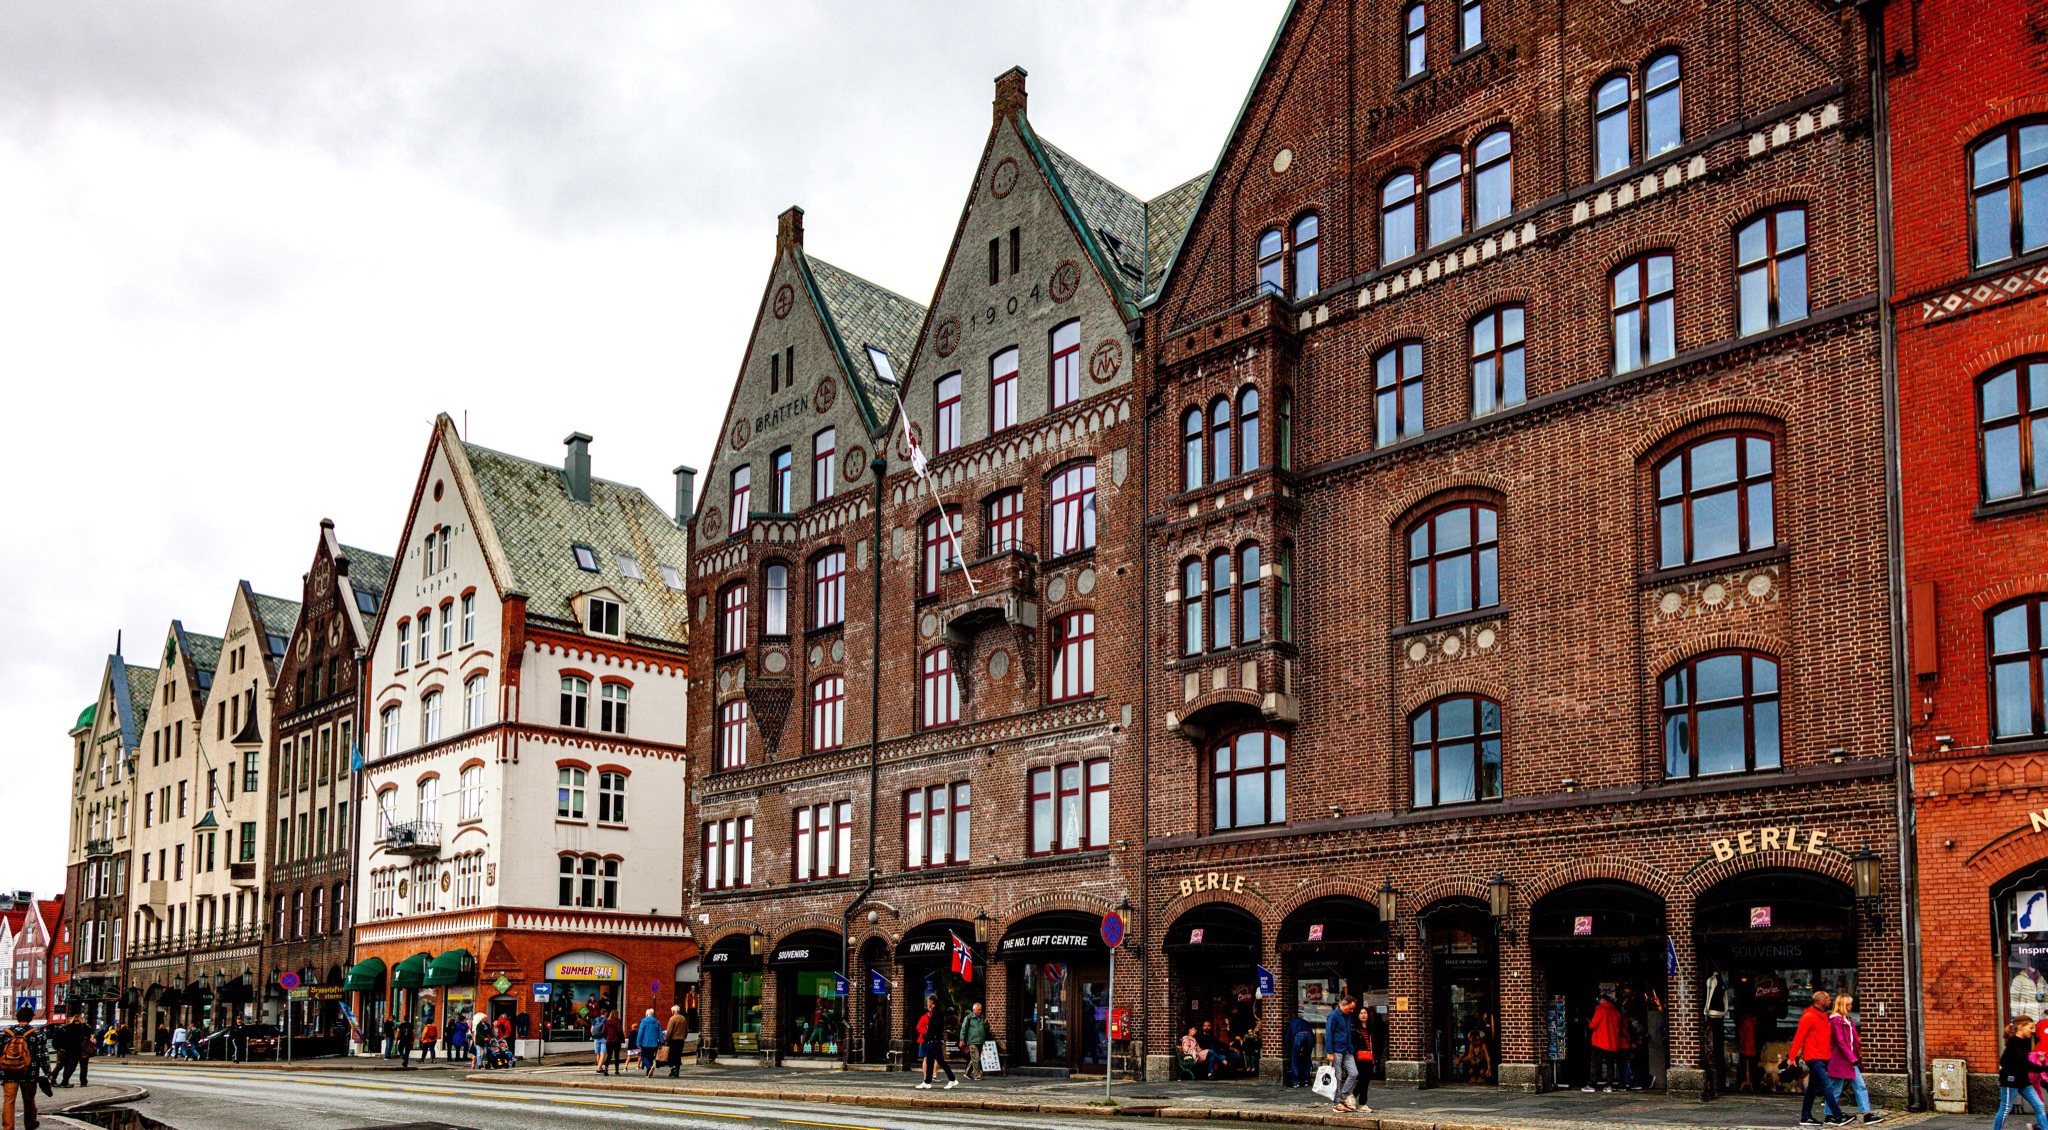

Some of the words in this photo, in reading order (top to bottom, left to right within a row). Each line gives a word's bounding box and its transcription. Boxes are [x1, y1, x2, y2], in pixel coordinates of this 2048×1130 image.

[970, 283, 1040, 332] 1904
[755, 395, 809, 433] BRATTEN
[1711, 827, 1828, 863] BERLE
[1179, 871, 1246, 898] BERLE
[910, 942, 946, 952] KNITWEAR
[1003, 940, 1014, 949] THE
[1015, 936, 1030, 948] NO.1
[1031, 935, 1050, 945] GIFT
[1051, 935, 1088, 946] CENTRE
[778, 950, 809, 960] SOUVENIRS
[1731, 945, 1802, 957] SOUVENIRS
[713, 953, 728, 962] GIFTS
[1611, 952, 1632, 964] GIFTS
[560, 966, 593, 975] SUMMER
[594, 966, 612, 976] SALE
